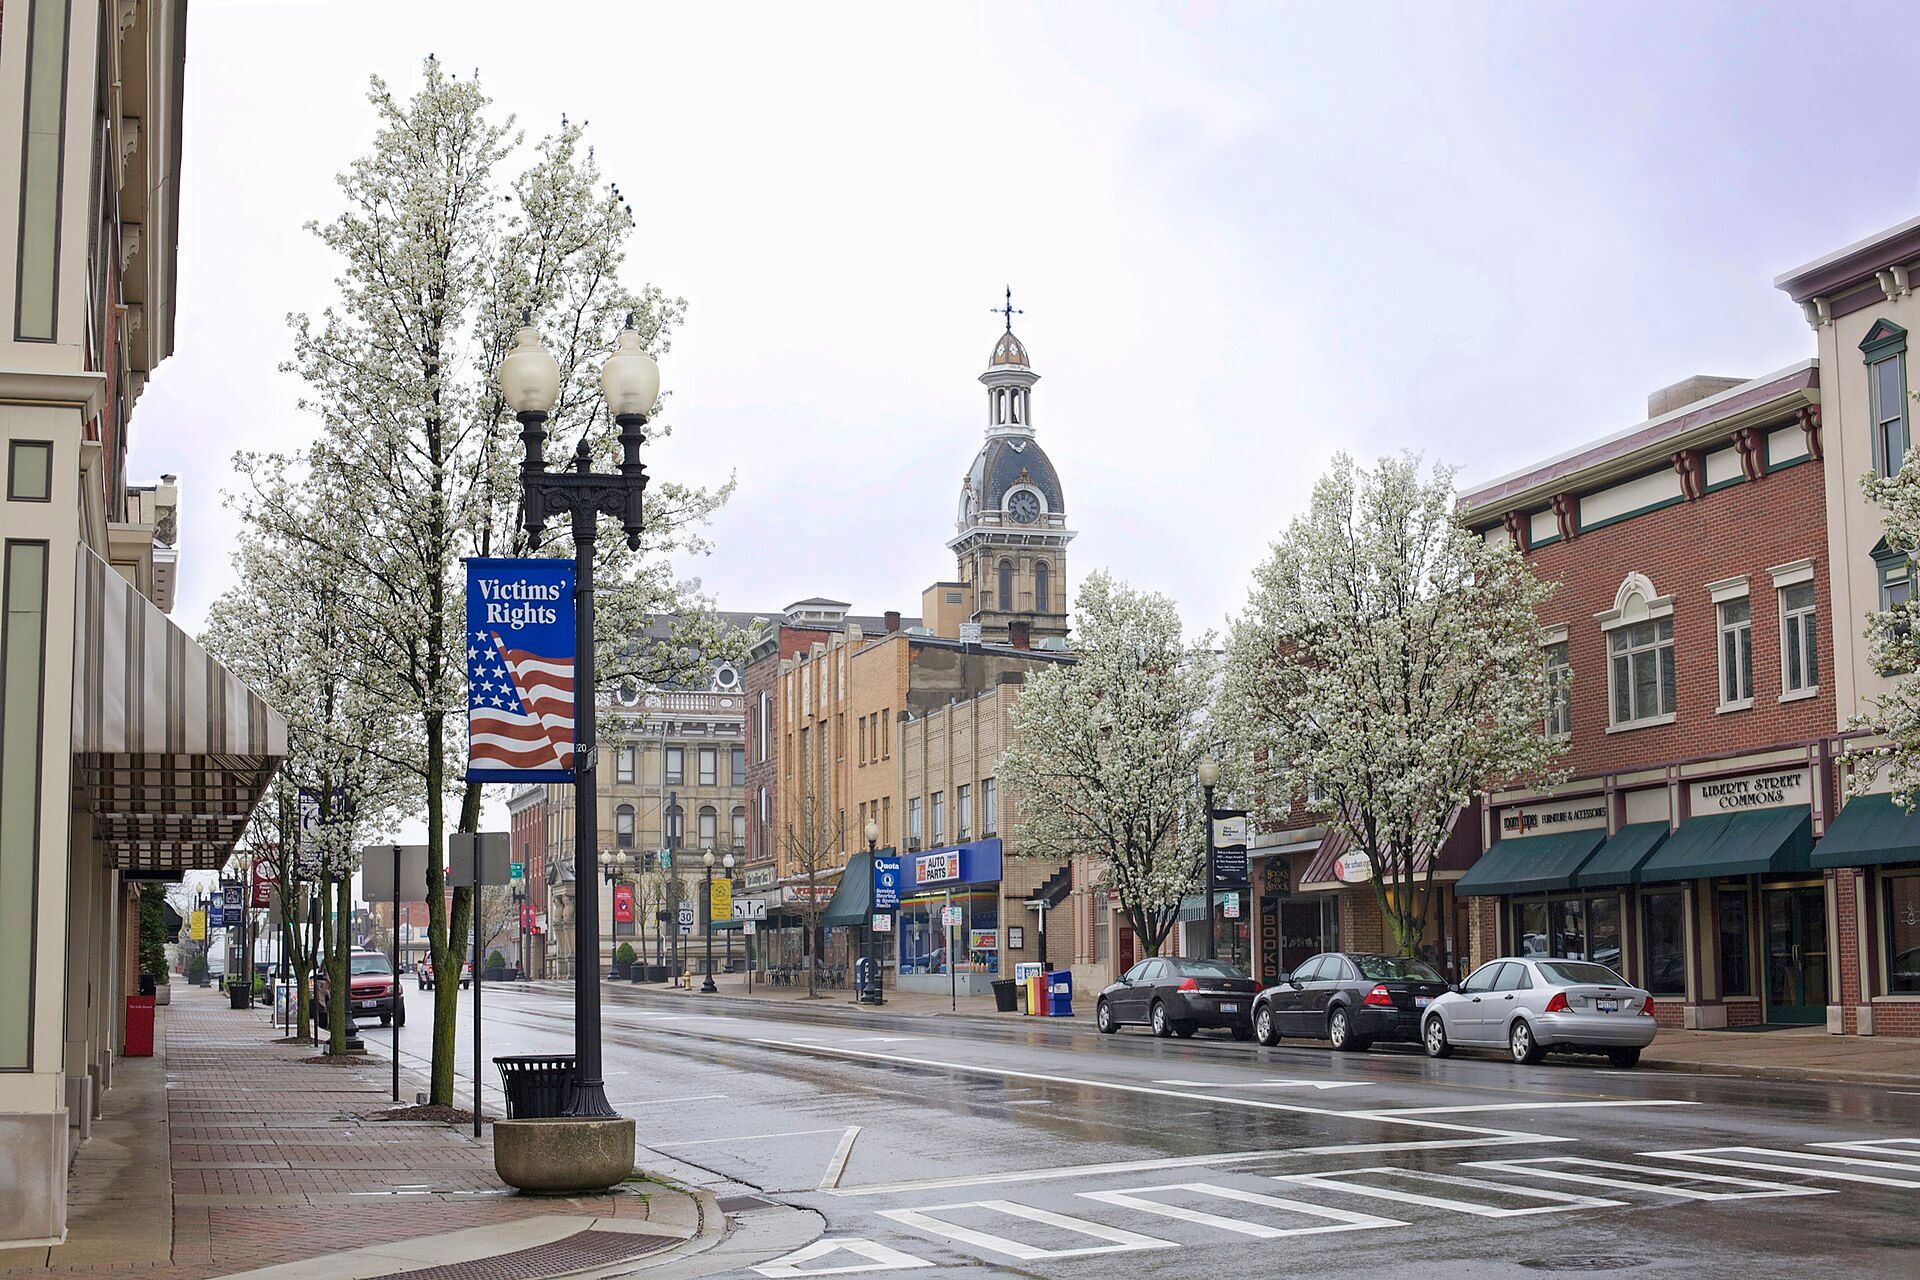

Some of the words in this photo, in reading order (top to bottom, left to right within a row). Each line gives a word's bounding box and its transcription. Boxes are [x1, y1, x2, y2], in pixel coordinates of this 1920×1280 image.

[478, 579, 566, 601] Victims'
[486, 602, 557, 630] Rights
[1701, 781, 1749, 798] LIBERTY
[1754, 774, 1802, 791] STREET
[1719, 789, 1784, 809] COMMONS
[1541, 812, 1568, 824] FURNITURE
[1567, 811, 1573, 821] &
[1573, 806, 1607, 821] ACCESSORIES
[875, 860, 899, 872] Quota
[928, 857, 945, 868] AUTO
[927, 868, 946, 880] PARTS
[680, 912, 691, 922] 30
[1264, 915, 1276, 976] BOOKS
